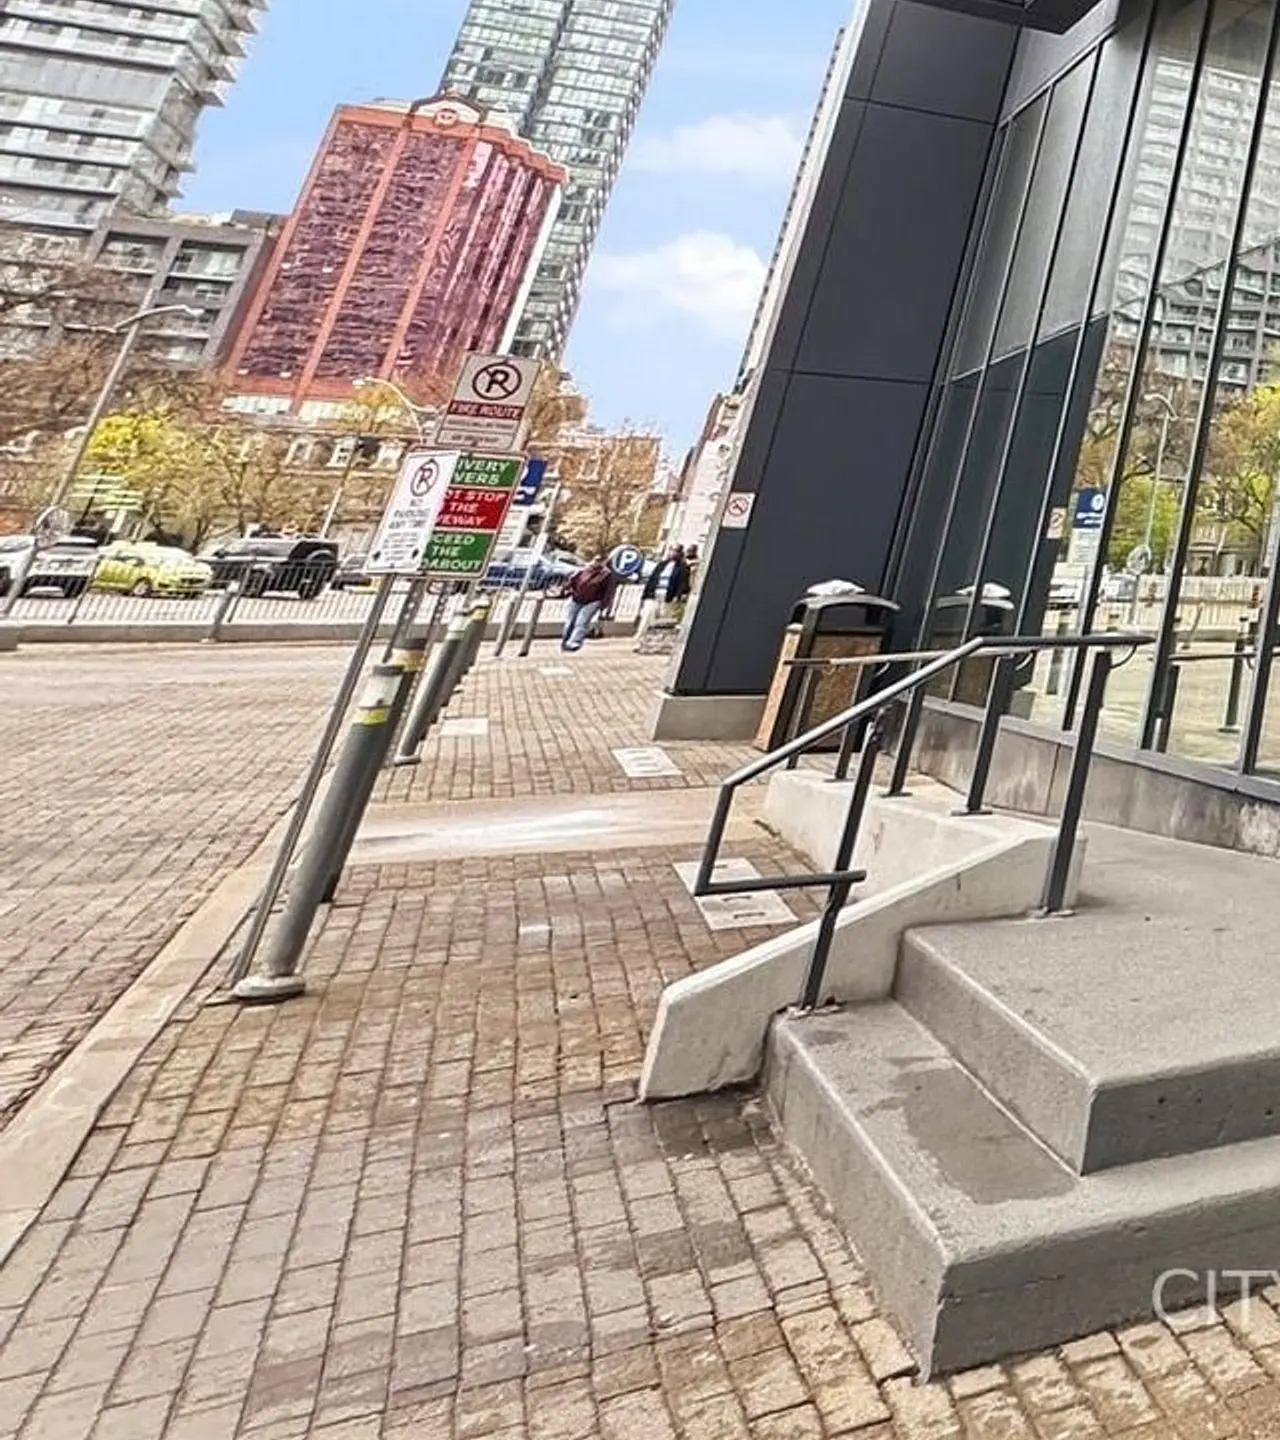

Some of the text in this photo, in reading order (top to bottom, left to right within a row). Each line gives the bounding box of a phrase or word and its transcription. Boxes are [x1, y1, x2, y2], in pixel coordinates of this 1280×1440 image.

[467, 490, 507, 502] STOP
[449, 502, 480, 513] THE
[432, 546, 461, 557] THE
